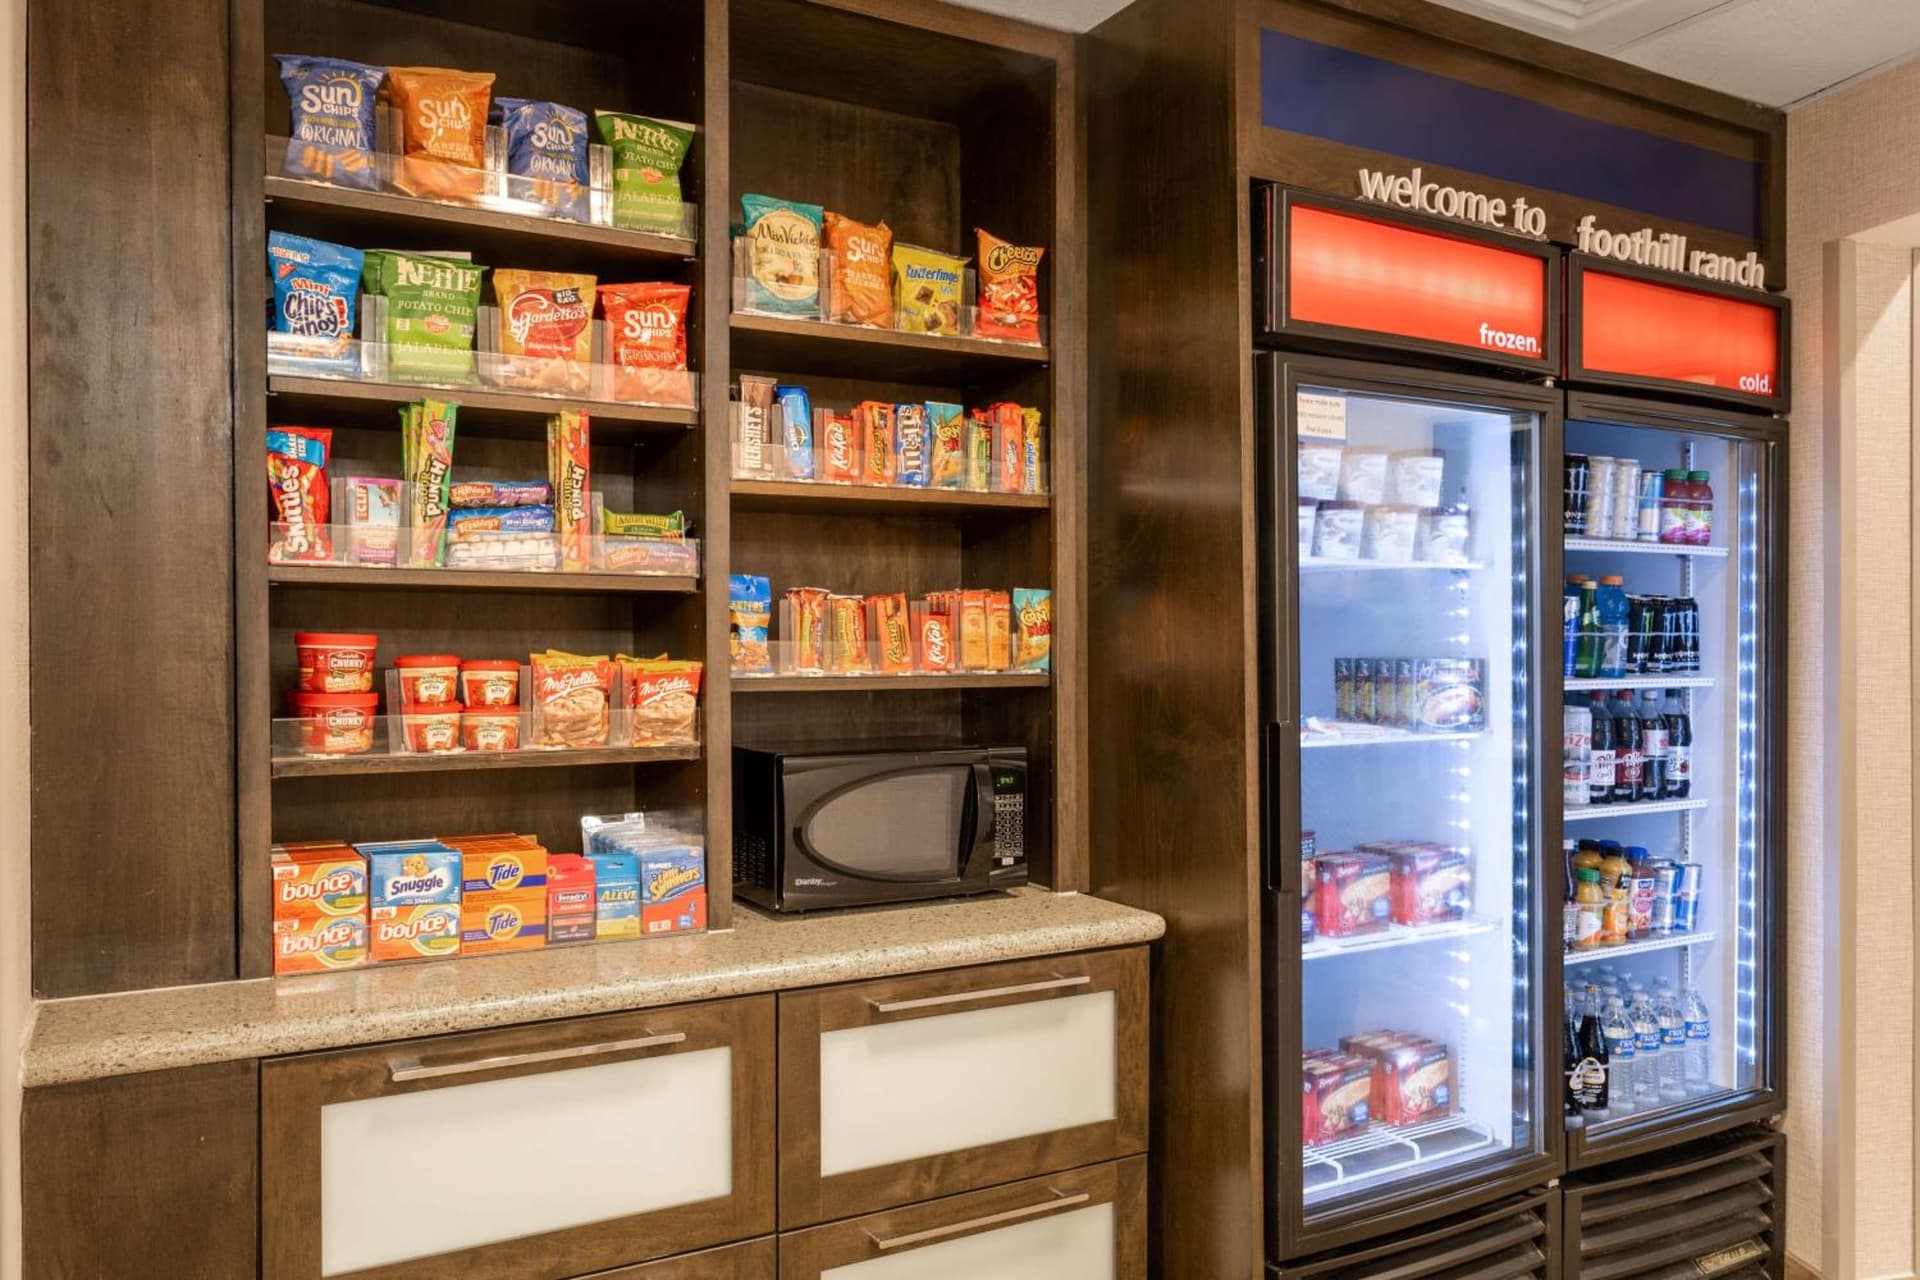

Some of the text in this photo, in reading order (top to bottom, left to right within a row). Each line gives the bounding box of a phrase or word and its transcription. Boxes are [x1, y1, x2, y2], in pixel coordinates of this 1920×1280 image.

[301, 84, 363, 114] Sun
[323, 103, 360, 118] CHIPS
[418, 97, 471, 130] Sun
[301, 123, 368, 151] ORIGINAL
[530, 121, 575, 149] Sun
[1359, 168, 1546, 236] welcome to
[756, 223, 784, 243] Miss
[847, 236, 885, 262] Sun
[1577, 215, 1765, 289] foothill ranch
[291, 278, 330, 297] Mini
[395, 256, 480, 292] KETTLE
[284, 291, 336, 320] Chips
[397, 299, 442, 313] POTATO
[422, 290, 456, 301] BRAND
[624, 308, 677, 340] Sun
[1479, 323, 1543, 354] frozen.
[1738, 373, 1773, 394] cold.
[743, 406, 762, 469] HERSHEY'S
[416, 471, 431, 505] SOUR
[425, 458, 448, 517] PUNCH
[563, 479, 573, 510] SOUR
[572, 464, 586, 521] PUNCH
[280, 464, 309, 553] Skittles
[330, 657, 365, 669] CHUNKY
[329, 716, 365, 728] CHUNKY
[281, 872, 354, 902] bounce
[391, 876, 444, 897] Snuggle
[489, 862, 520, 886] Tide
[601, 890, 637, 902] ALEVE
[379, 914, 448, 942] bounce
[487, 912, 518, 936] Tide
[281, 924, 353, 956] bounce
